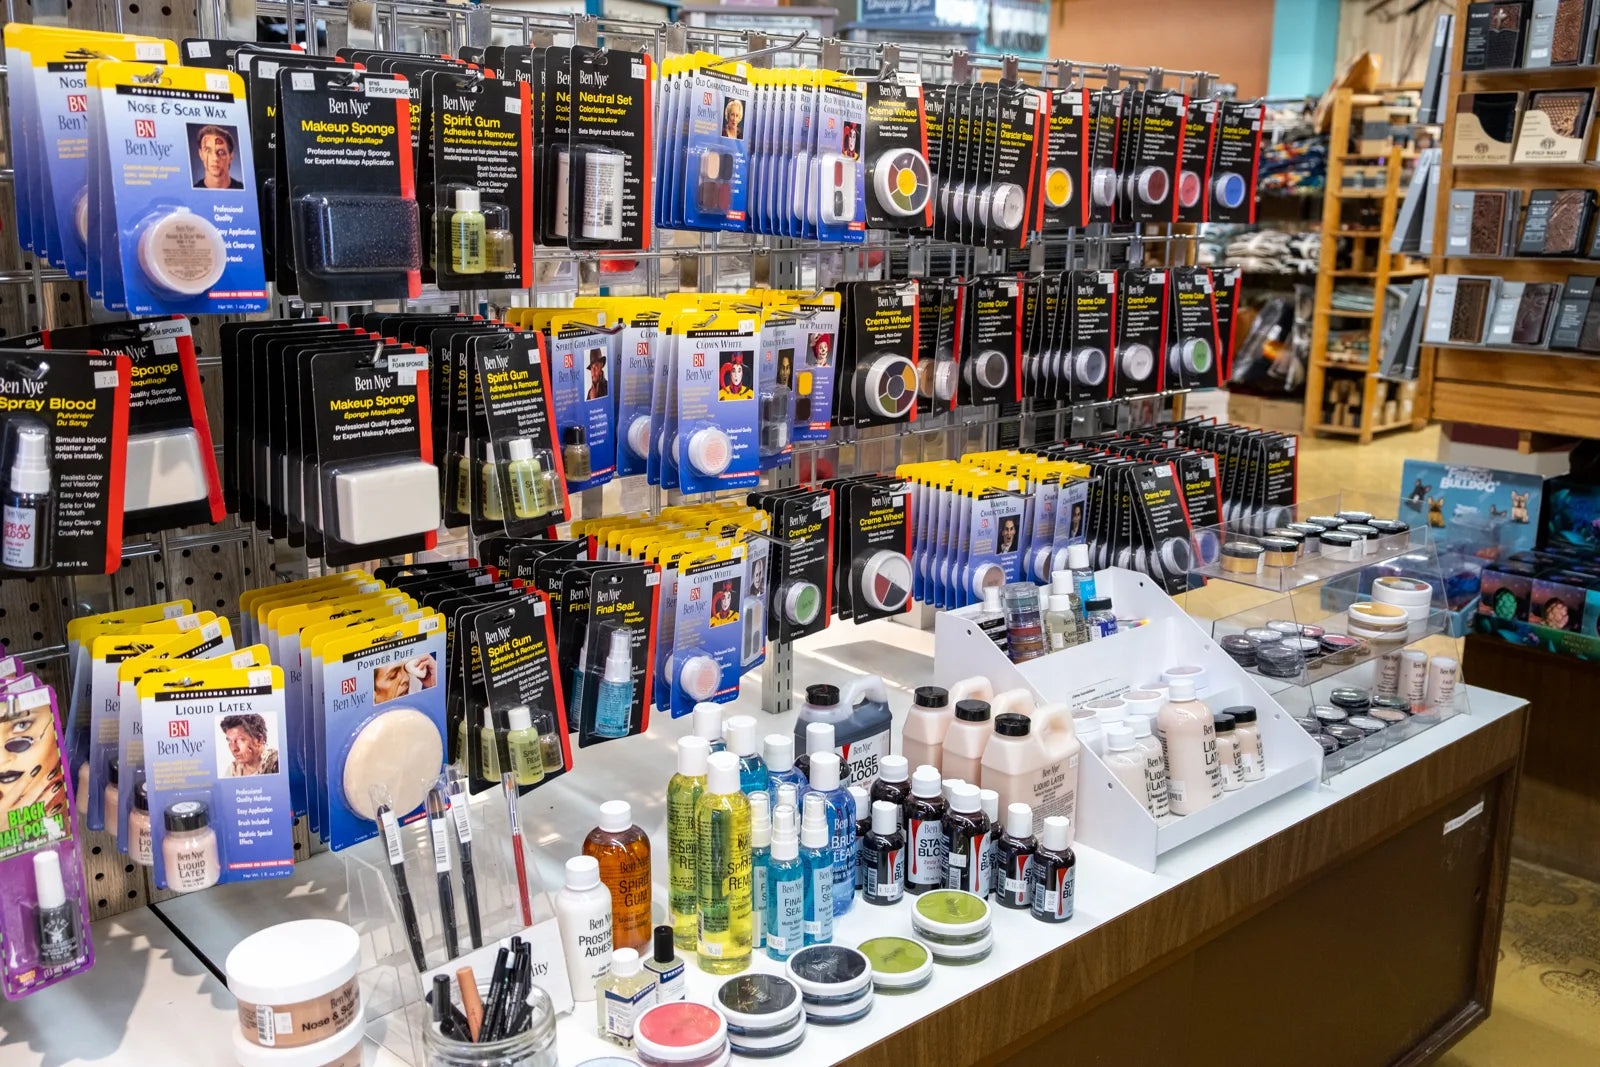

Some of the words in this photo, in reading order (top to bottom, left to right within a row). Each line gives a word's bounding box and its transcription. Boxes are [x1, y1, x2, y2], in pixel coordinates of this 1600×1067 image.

[579, 69, 594, 85] Ben
[368, 86, 388, 95] STIPPLE
[388, 87, 409, 96] SPONGE
[695, 77, 706, 87] OLD
[706, 79, 731, 94] CHARACTER
[731, 85, 750, 97] PALETTE
[329, 97, 349, 114] Ben
[442, 94, 460, 112] Ben
[579, 91, 615, 105] Neutral
[616, 93, 633, 106] Set
[878, 100, 906, 108] Professional
[127, 100, 158, 114] NOSE
[161, 102, 171, 115] &
[174, 103, 201, 118] SCAR
[204, 106, 228, 120] WAX
[578, 104, 604, 115] Colorless
[605, 106, 627, 116] Powder
[867, 106, 893, 116] Creme
[894, 108, 918, 117] Wheel
[301, 120, 350, 136] Makeup
[351, 121, 396, 136] Sponge
[442, 113, 473, 130] Spirit
[474, 115, 502, 129] Gum
[1057, 116, 1074, 126] Color
[1144, 117, 1158, 126] Creme
[1158, 117, 1174, 127] Color
[136, 121, 156, 138] BN
[442, 127, 476, 138] Adhesive
[477, 129, 483, 138] &
[483, 129, 516, 140] Remover
[316, 133, 344, 146] Éponge
[346, 135, 384, 146] Maquillage
[1020, 132, 1033, 142] Base
[125, 138, 147, 156] Ben
[306, 147, 345, 157] Professional
[346, 148, 366, 158] Quality
[367, 149, 391, 159] Sponge
[304, 157, 314, 166] for
[315, 157, 335, 168] Expert
[335, 158, 360, 168] Makeup
[361, 158, 395, 167] Application
[213, 204, 244, 214] Professional
[977, 300, 994, 309] Creme
[995, 300, 1009, 308] Color
[1077, 297, 1093, 306] Creme
[1093, 297, 1107, 306] Color
[1128, 296, 1144, 304] Creme
[1144, 296, 1157, 304] Color
[865, 317, 888, 326] Creme
[889, 314, 912, 325] Wheel
[555, 341, 573, 352] SPIRIT
[573, 340, 586, 350] GUM
[586, 337, 608, 348] ADHESIVE
[636, 342, 648, 356] BN
[696, 340, 718, 350] CLOWN
[720, 338, 743, 349] WHITE
[391, 360, 406, 369] FOAM
[406, 359, 425, 368] SPONGE
[564, 354, 574, 368] BN
[693, 354, 704, 368] BN
[130, 363, 179, 378] Sponge
[487, 372, 509, 384] Spirit
[510, 370, 529, 381] Gum
[685, 368, 698, 382] Ben
[354, 375, 373, 392] Ben
[0, 397, 45, 412] Spray
[49, 397, 96, 411] Blood
[145, 394, 182, 406] Application
[330, 397, 374, 412] Makeup
[375, 392, 416, 408] Sponge
[343, 408, 370, 421] Éponge
[370, 406, 405, 419] Maquillage
[335, 422, 370, 432] Professional
[371, 420, 391, 430] Quality
[391, 417, 412, 428] Sponge
[55, 435, 85, 444] Simulate
[86, 435, 107, 444] blood
[333, 433, 342, 441] for
[342, 431, 360, 441] Expert
[361, 428, 384, 439] Makeup
[384, 425, 415, 437] Application
[55, 444, 81, 453] splatter
[83, 444, 96, 452] and
[54, 452, 73, 461] drips
[74, 452, 104, 461] instantly.
[60, 474, 86, 482] Realistic
[87, 474, 103, 482] Color
[72, 480, 100, 489] Viscosity
[60, 492, 74, 500] Easy
[82, 490, 100, 500] Apply
[1144, 492, 1158, 500] Creme
[1158, 490, 1171, 498] Color
[59, 502, 73, 510] Safe
[74, 502, 82, 510] for
[83, 502, 96, 510] Use
[869, 508, 894, 516] Professional
[58, 519, 74, 527] Easy
[75, 519, 101, 527] Clean-up
[860, 516, 882, 527] Creme
[882, 512, 904, 523] Wheel
[58, 528, 77, 537] Cruelty
[78, 528, 94, 536] Free
[788, 527, 807, 538] Creme
[808, 523, 822, 533] Color
[693, 574, 713, 585] CLOWN
[714, 569, 732, 580] WHITE
[597, 588, 610, 603] Ben
[596, 604, 615, 616] Final
[616, 601, 635, 613] Seal
[485, 631, 498, 645] Ben
[488, 642, 511, 658] Spirit
[512, 634, 532, 648] Gum
[356, 656, 392, 671] POWDER
[393, 648, 415, 662] PUFF
[170, 688, 229, 699] PROFESSIONAL
[231, 688, 258, 696] SERIES
[342, 678, 357, 695] BN
[175, 703, 215, 717] LIQUID
[219, 701, 253, 713] LATEX
[333, 696, 350, 713] Ben
[169, 721, 189, 737] BN
[157, 739, 179, 755] Ben
[1034, 779, 1050, 792] LIQUID
[1050, 774, 1065, 787] LATEX
[8, 800, 46, 827] BLACK
[178, 860, 206, 871] LIQUID
[180, 868, 206, 878] LATEX
[625, 889, 648, 907] GUM
[589, 918, 604, 931] Ben
[302, 1017, 330, 1032] Nose
